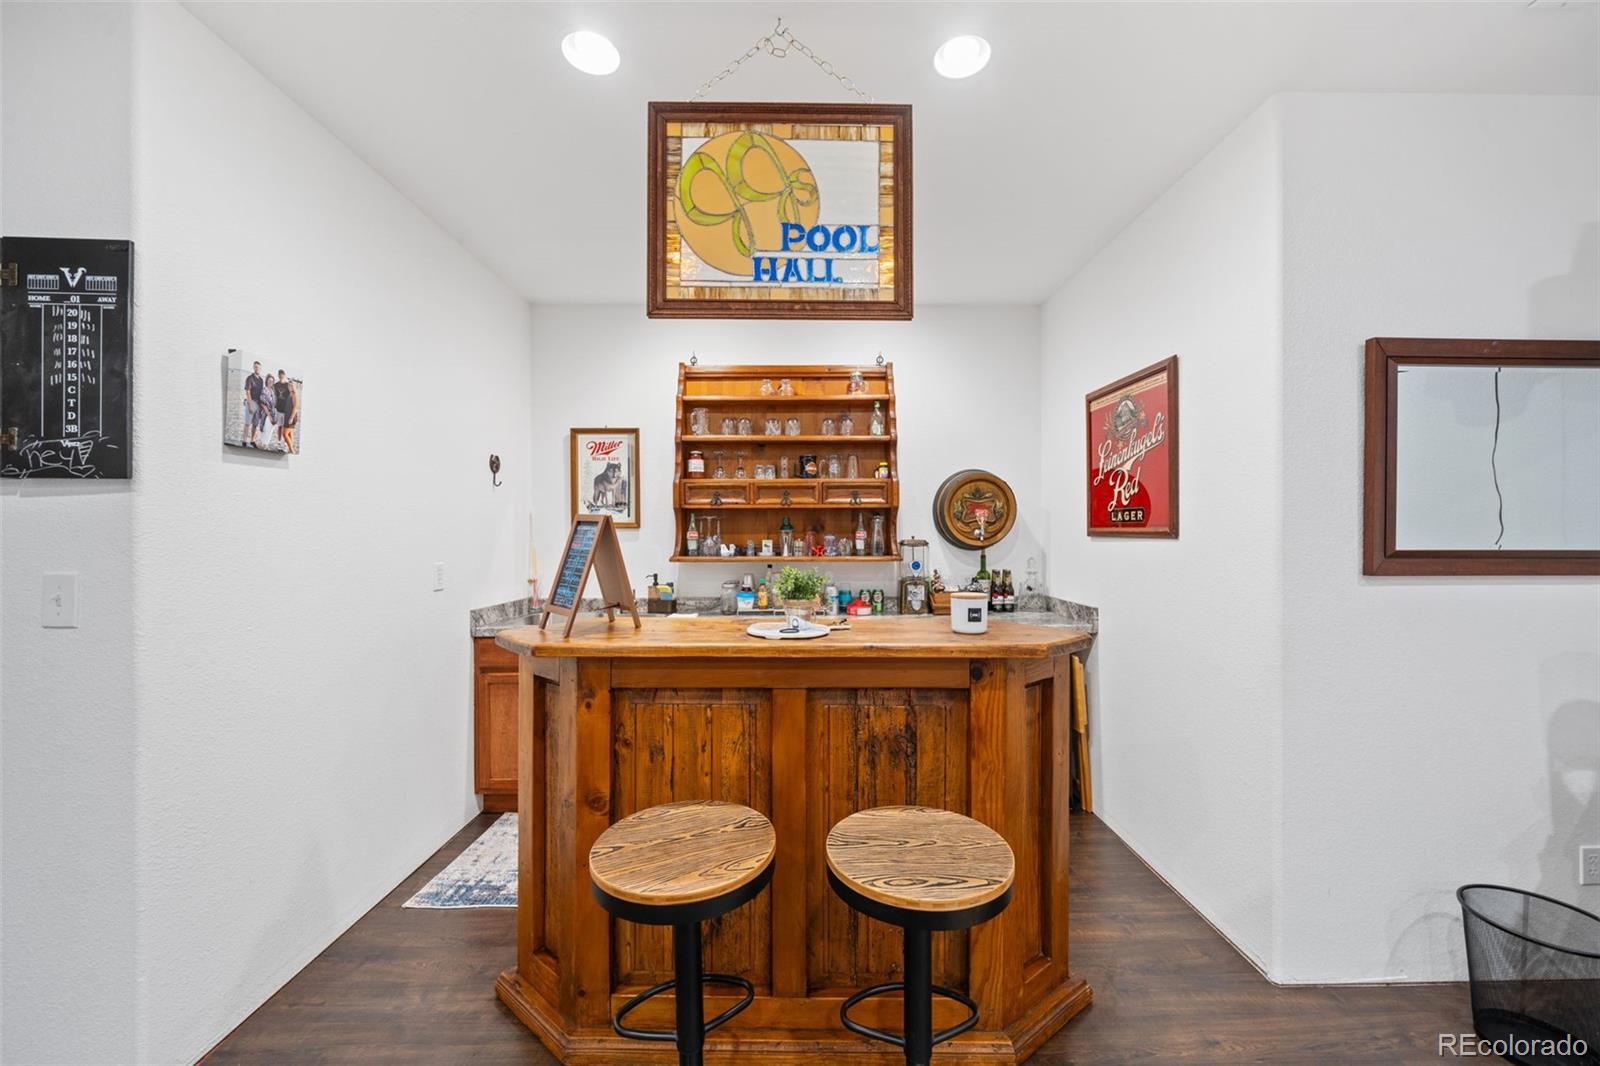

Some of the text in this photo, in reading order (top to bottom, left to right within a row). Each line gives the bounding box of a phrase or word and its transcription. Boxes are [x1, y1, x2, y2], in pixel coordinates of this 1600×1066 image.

[781, 222, 880, 253] POOL
[753, 256, 843, 283] HALL
[67, 309, 78, 317] 20
[67, 322, 78, 330] 19
[67, 335, 78, 343] 18
[67, 347, 78, 355] 17
[67, 360, 78, 368] 16
[67, 373, 78, 381] 15
[67, 386, 76, 394] C
[67, 399, 76, 407] T
[67, 412, 76, 420] D
[65, 425, 78, 433] 3B
[586, 440, 623, 456] Miller
[1093, 411, 1165, 486] Leinenkugel's
[1108, 466, 1141, 511] Red
[1111, 509, 1144, 522] LAGER
